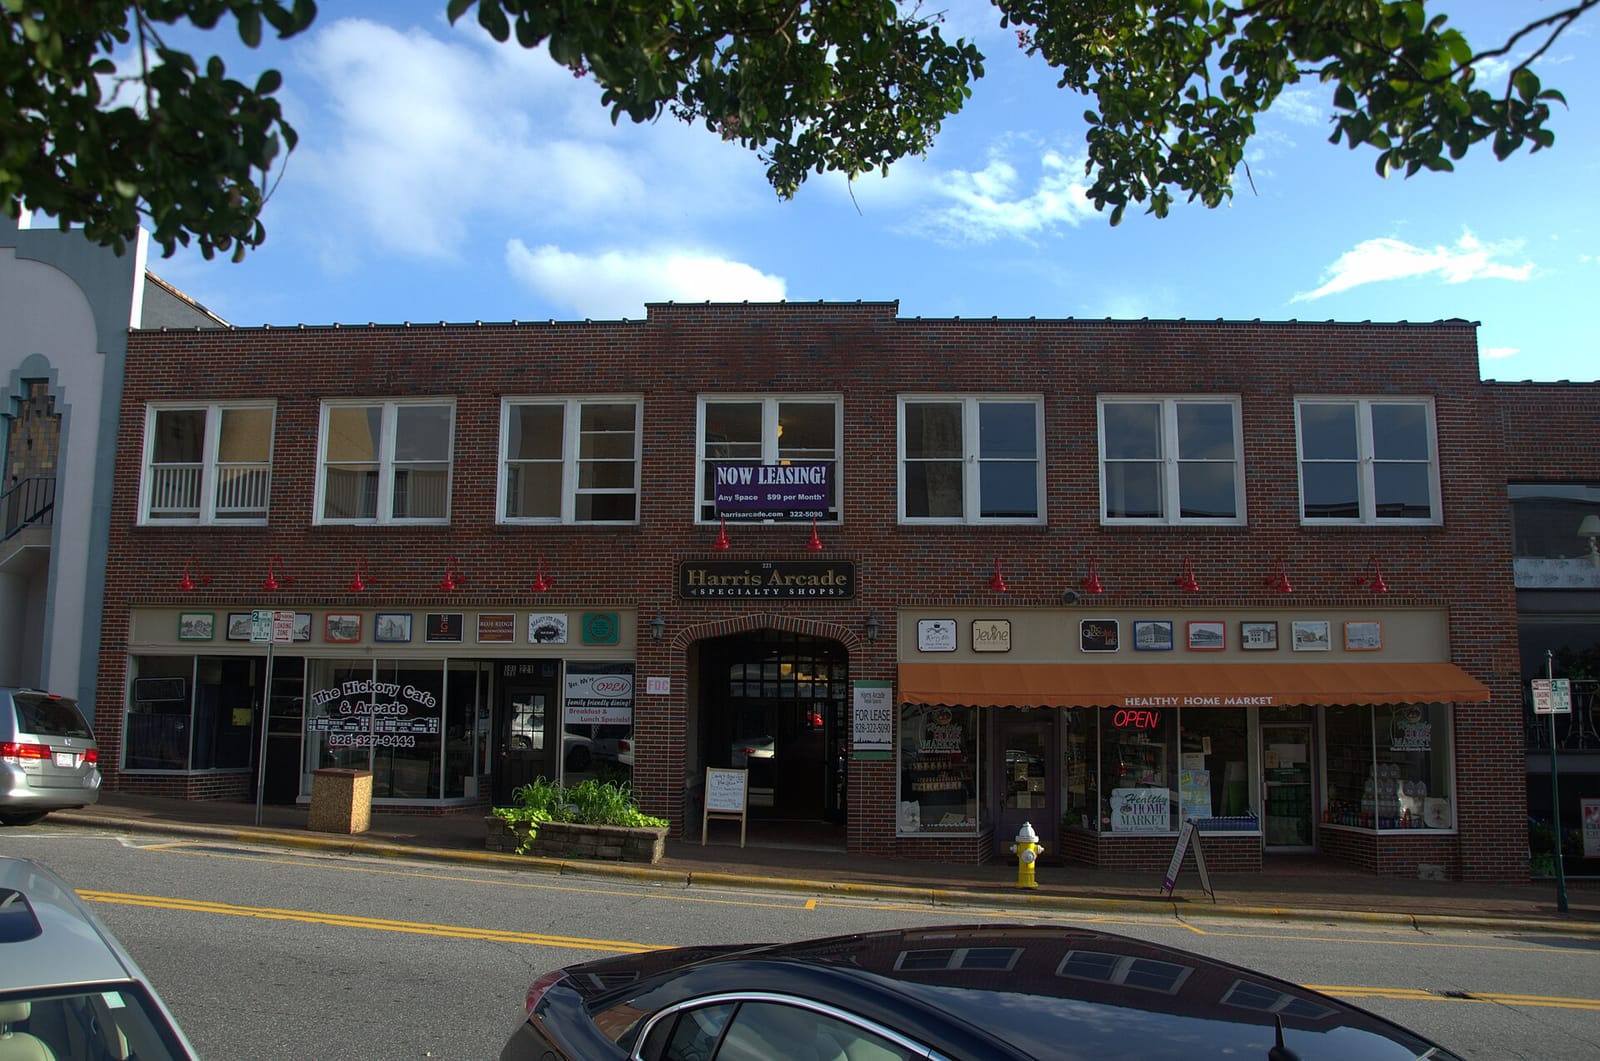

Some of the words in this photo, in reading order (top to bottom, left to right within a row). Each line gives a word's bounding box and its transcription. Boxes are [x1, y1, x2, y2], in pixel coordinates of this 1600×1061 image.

[717, 466, 754, 485] NOW
[758, 466, 827, 485] LEASING!
[718, 494, 732, 502] Any
[734, 494, 759, 502] Space
[767, 493, 782, 501] $99
[687, 569, 762, 586] Harris
[767, 569, 847, 586] Arcade
[596, 682, 629, 692] OPEN
[311, 688, 341, 705] The
[342, 680, 401, 697] Hickory
[403, 685, 436, 708] Cafe
[1125, 697, 1179, 706] HEALTHY
[1183, 696, 1220, 705] HOME
[1224, 696, 1273, 705] MARKET
[340, 700, 352, 714] &
[354, 701, 408, 715] Arcade
[855, 709, 869, 721] FOR
[870, 709, 891, 721] LEASE
[1113, 709, 1159, 729] OPEN
[855, 723, 891, 733] 828-322-5090
[329, 735, 416, 748] 828-327-9444
[1125, 793, 1168, 806] Healthy
[1133, 803, 1166, 815] HOME
[1120, 815, 1167, 825] MARKET
